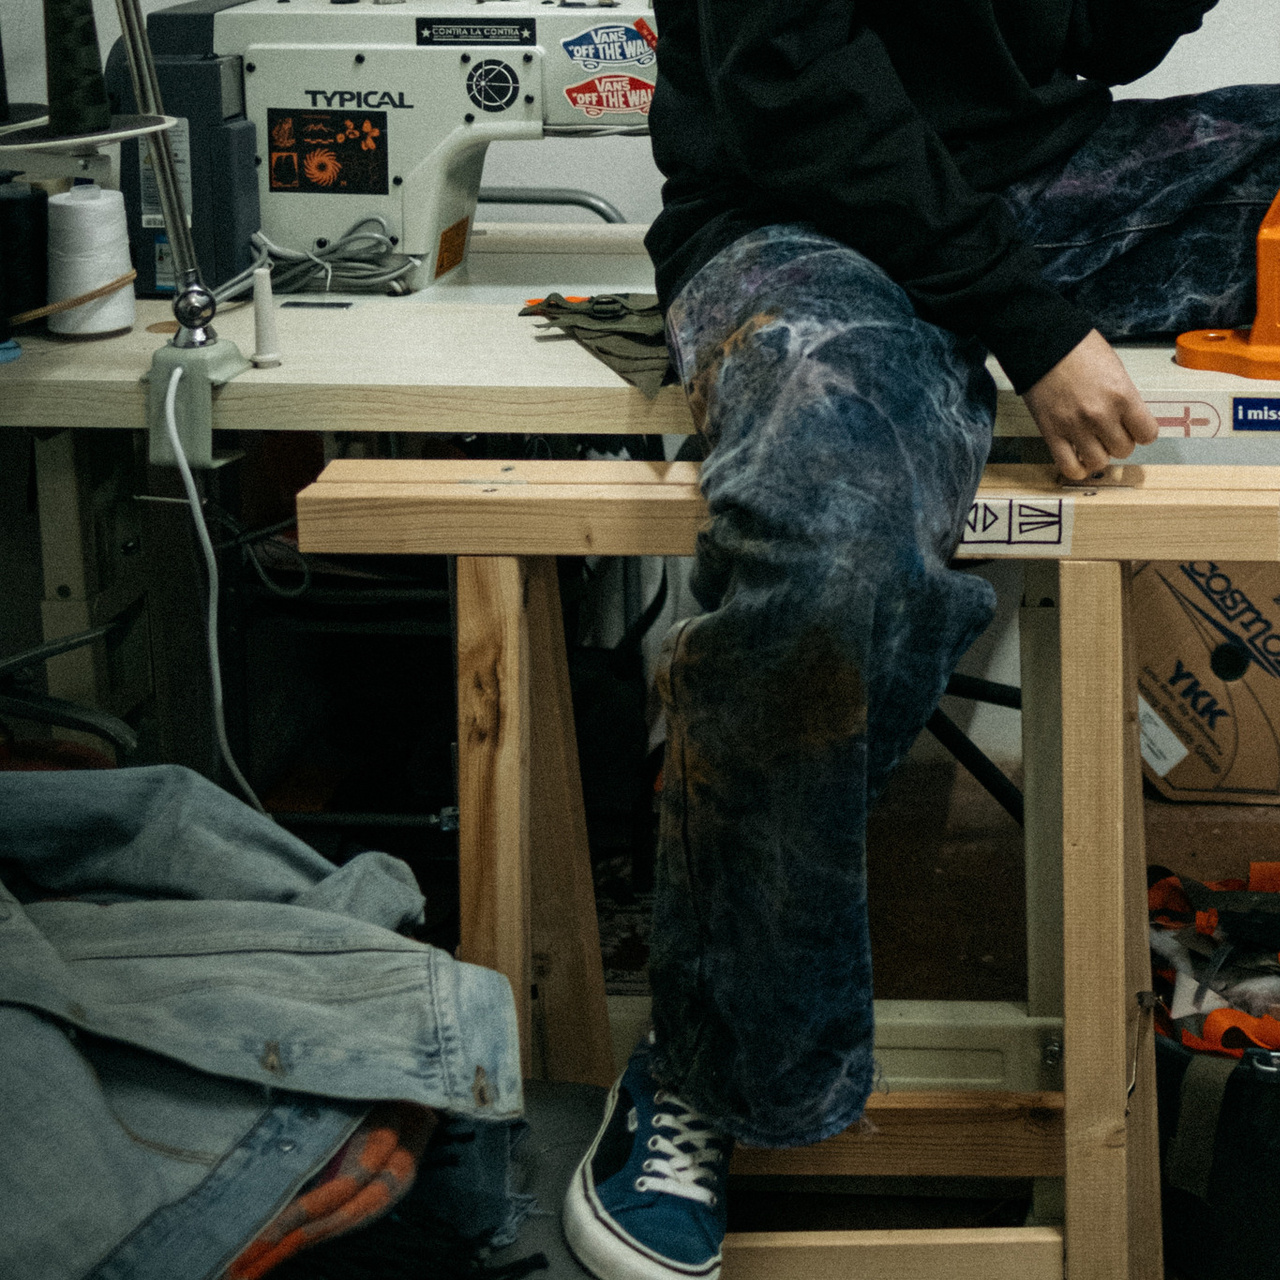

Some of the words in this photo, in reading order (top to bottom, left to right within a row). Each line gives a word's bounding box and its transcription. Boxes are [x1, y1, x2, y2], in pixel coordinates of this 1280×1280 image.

[432, 27, 468, 36] CONTRA
[470, 28, 481, 36] LA
[483, 28, 520, 36] CONTRA
[590, 27, 627, 44] VANS
[597, 42, 623, 60] THE
[594, 77, 631, 92] VANS
[304, 90, 414, 109] TYPICAL
[600, 90, 627, 108] THE
[627, 88, 655, 108] WAL
[1238, 405, 1243, 420] i
[1168, 659, 1230, 732] YKK
